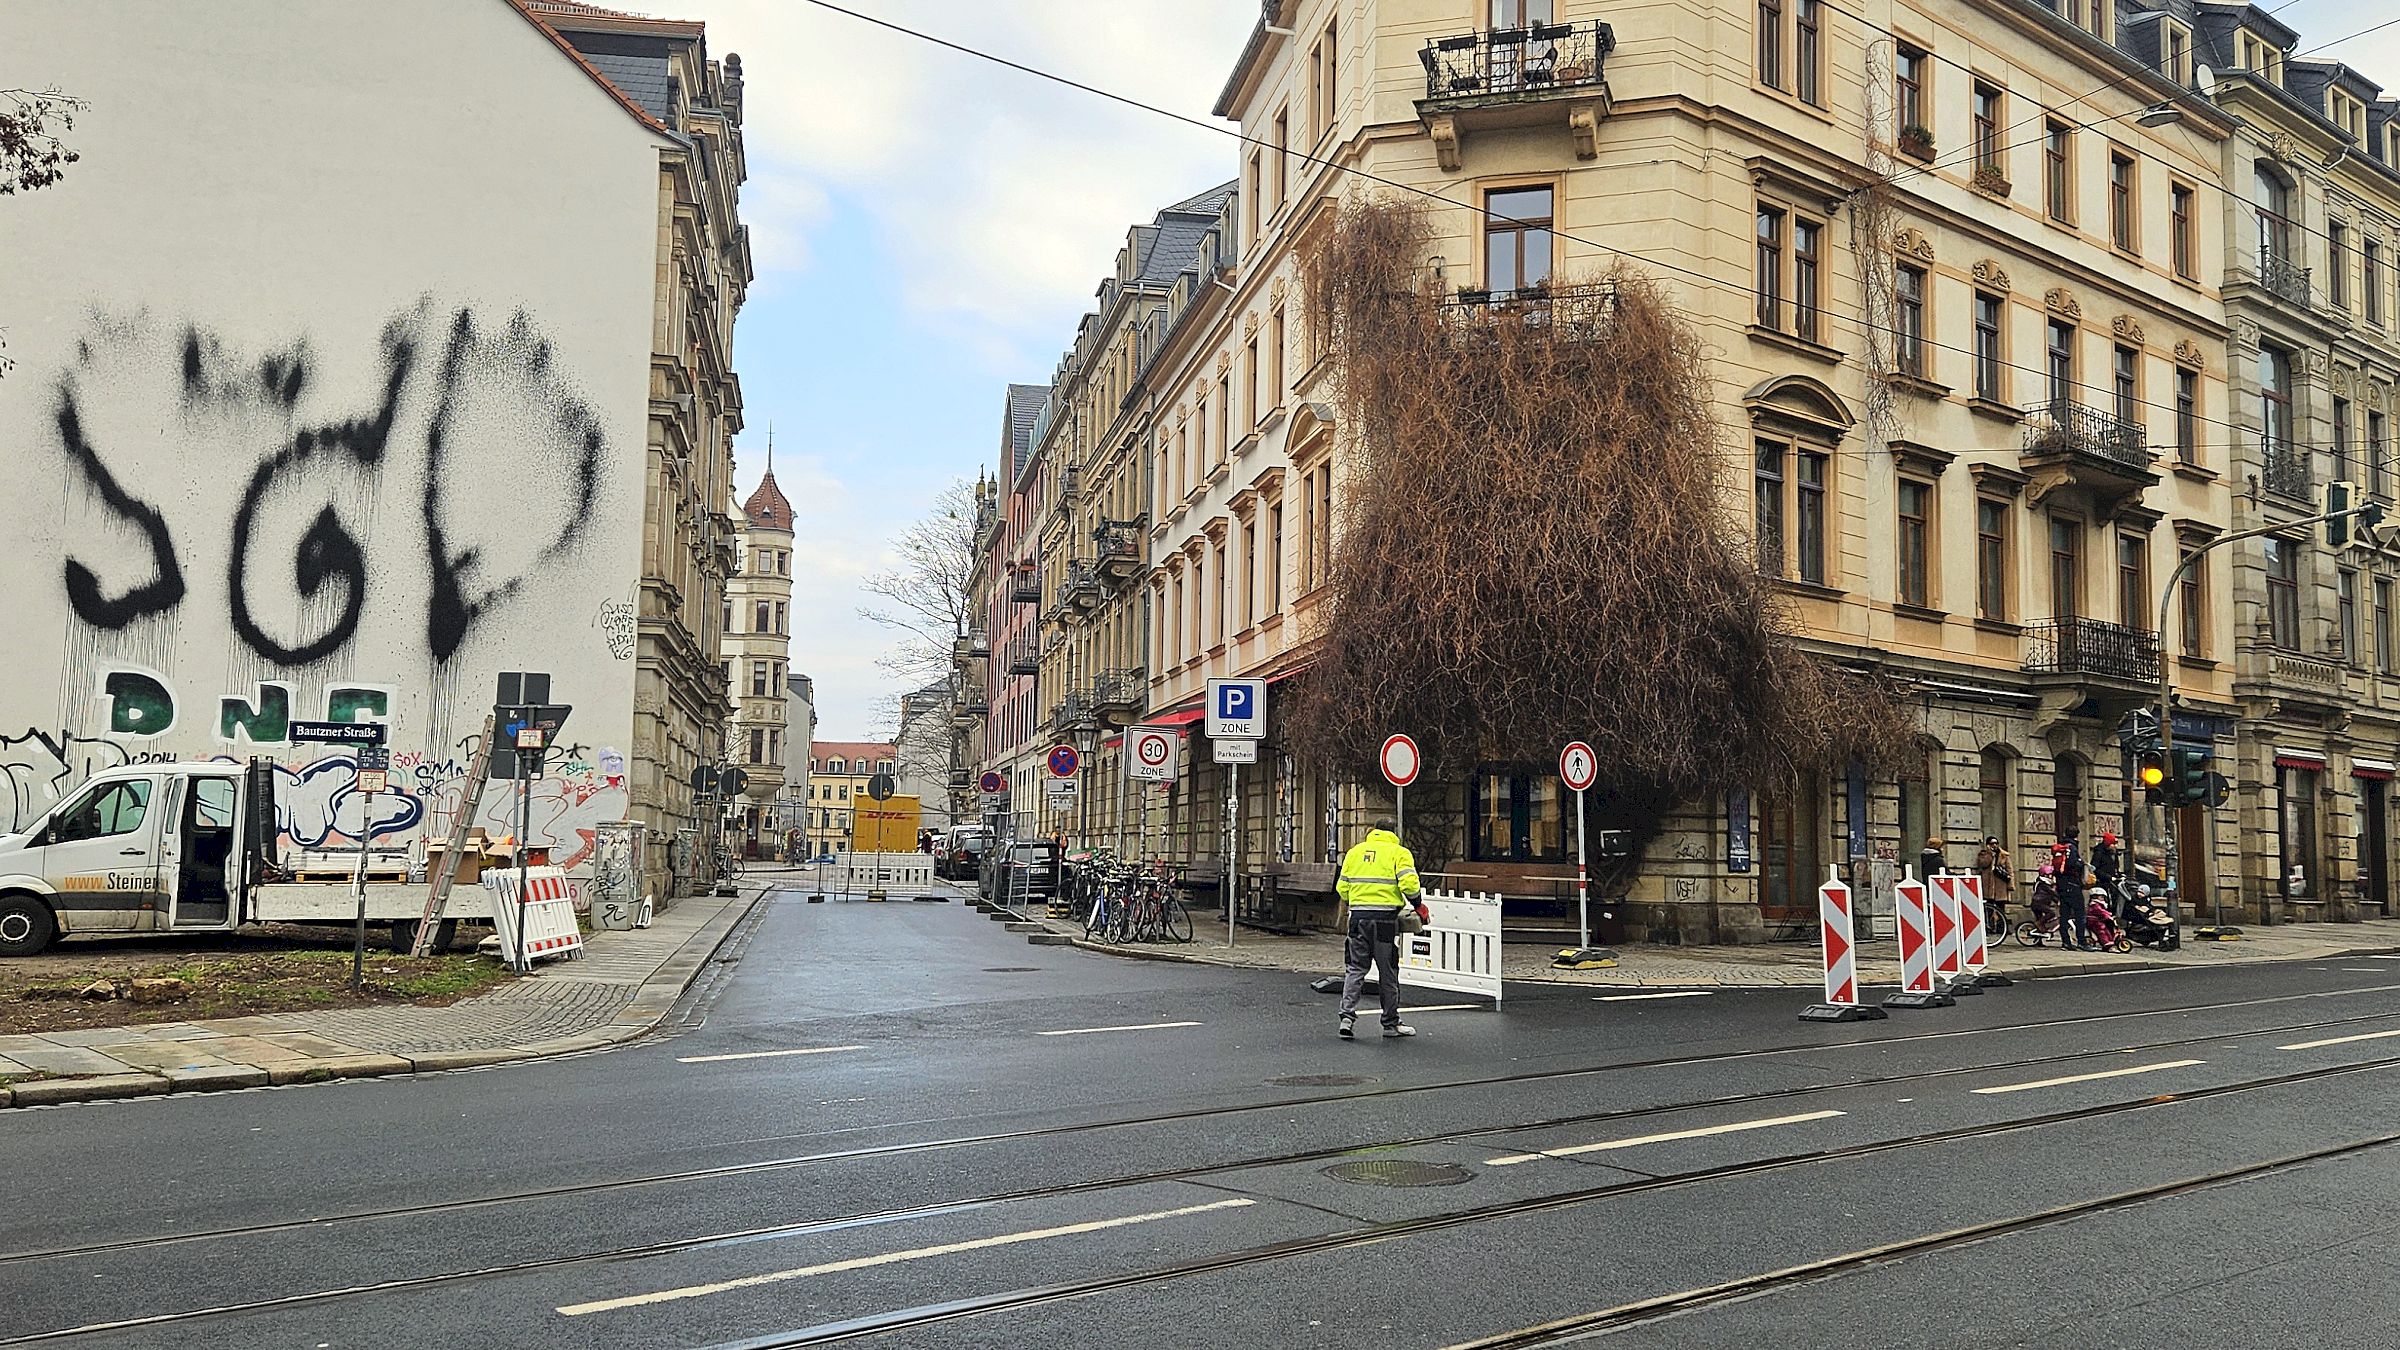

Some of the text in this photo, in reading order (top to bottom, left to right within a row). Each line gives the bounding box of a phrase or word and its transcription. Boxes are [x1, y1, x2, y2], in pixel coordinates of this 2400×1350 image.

[1226, 689, 1245, 715] P
[295, 725, 377, 738] Bautzner Straße
[1221, 723, 1251, 733] ZONE
[1144, 742, 1162, 757] 30
[1217, 750, 1253, 758] Parkschein
[1140, 766, 1164, 777] ZONE
